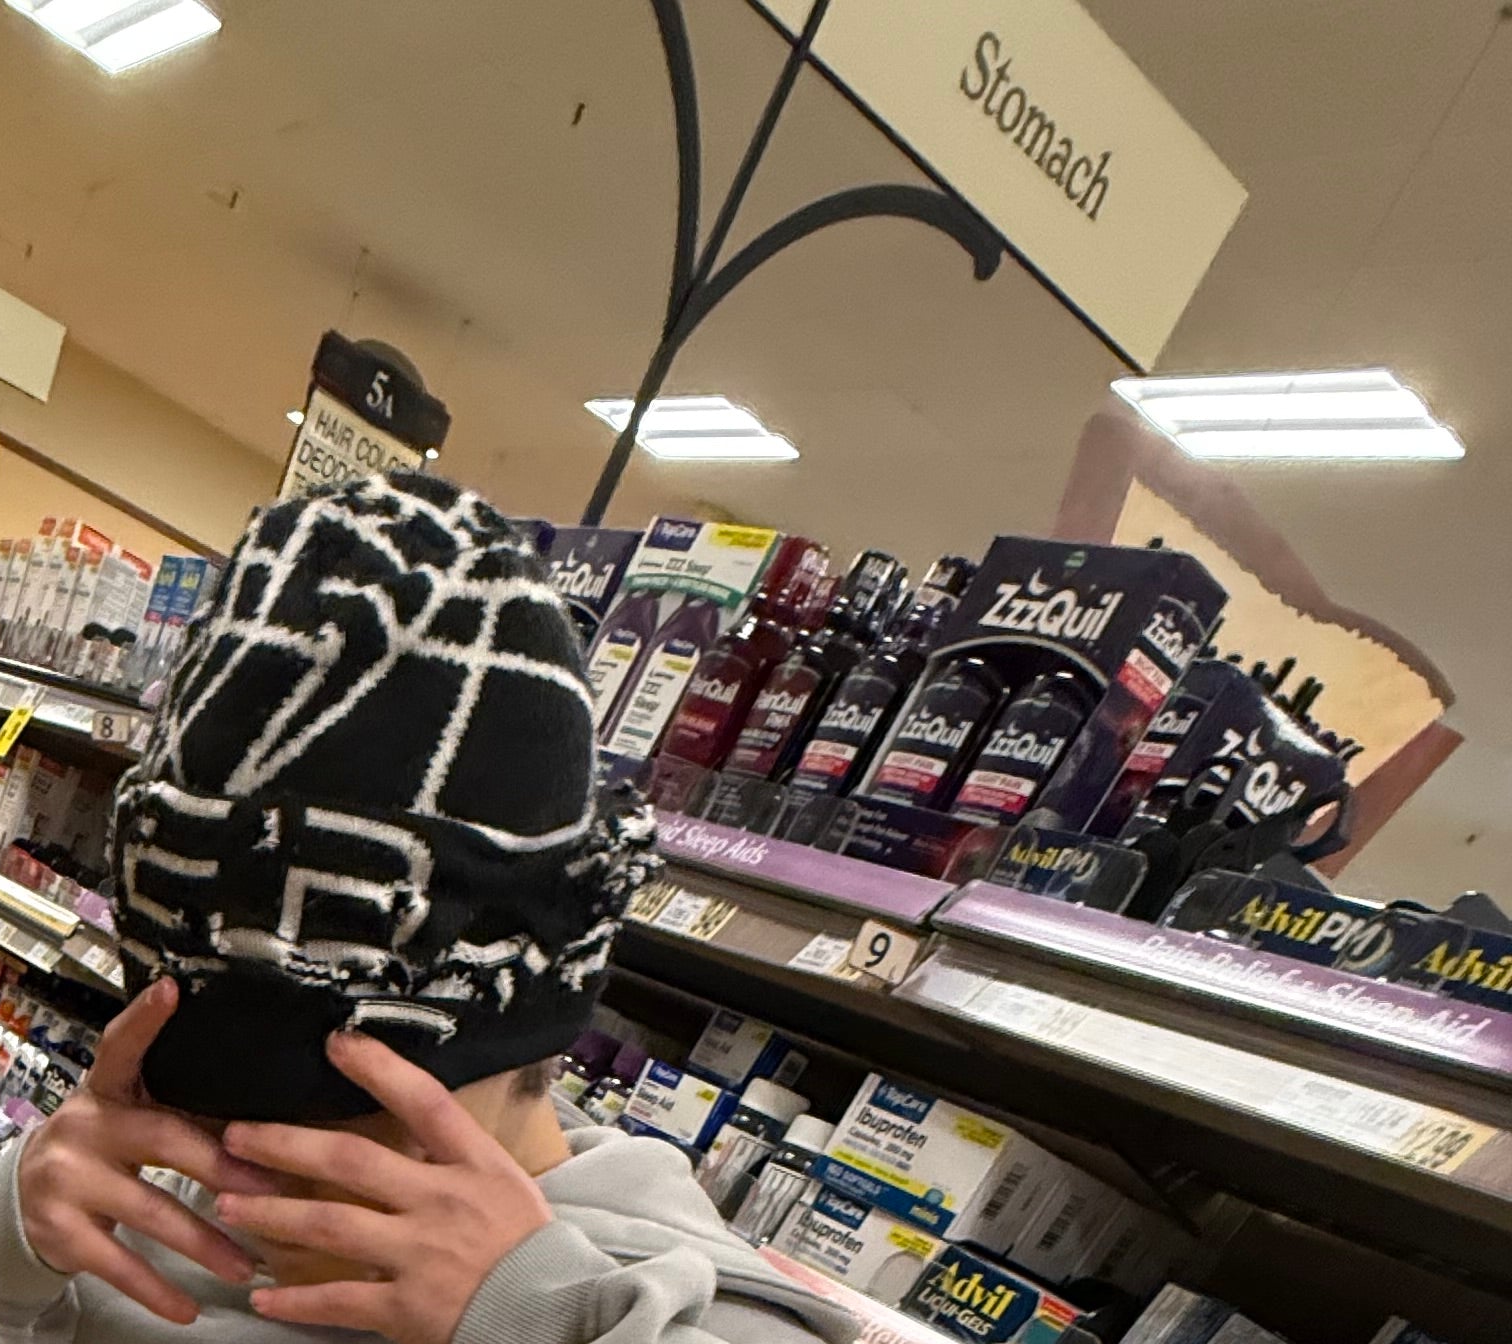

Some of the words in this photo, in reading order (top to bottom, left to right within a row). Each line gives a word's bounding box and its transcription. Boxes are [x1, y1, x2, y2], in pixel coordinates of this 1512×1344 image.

[960, 31, 1113, 222] Stomach
[315, 409, 354, 452] HAIR
[979, 580, 1123, 642] ZzzQuil
[100, 715, 114, 739] 8
[818, 701, 884, 735] ZzzQuil
[898, 711, 974, 750] ZzzQuil
[981, 728, 1065, 770] ZzzQuil
[685, 825, 728, 858] Sleep
[723, 838, 769, 865] Aids
[864, 931, 892, 968] 9
[856, 1106, 928, 1149] Ibuprofen
[797, 1210, 864, 1255] Ibuprofen
[934, 1261, 1019, 1321] Advil
